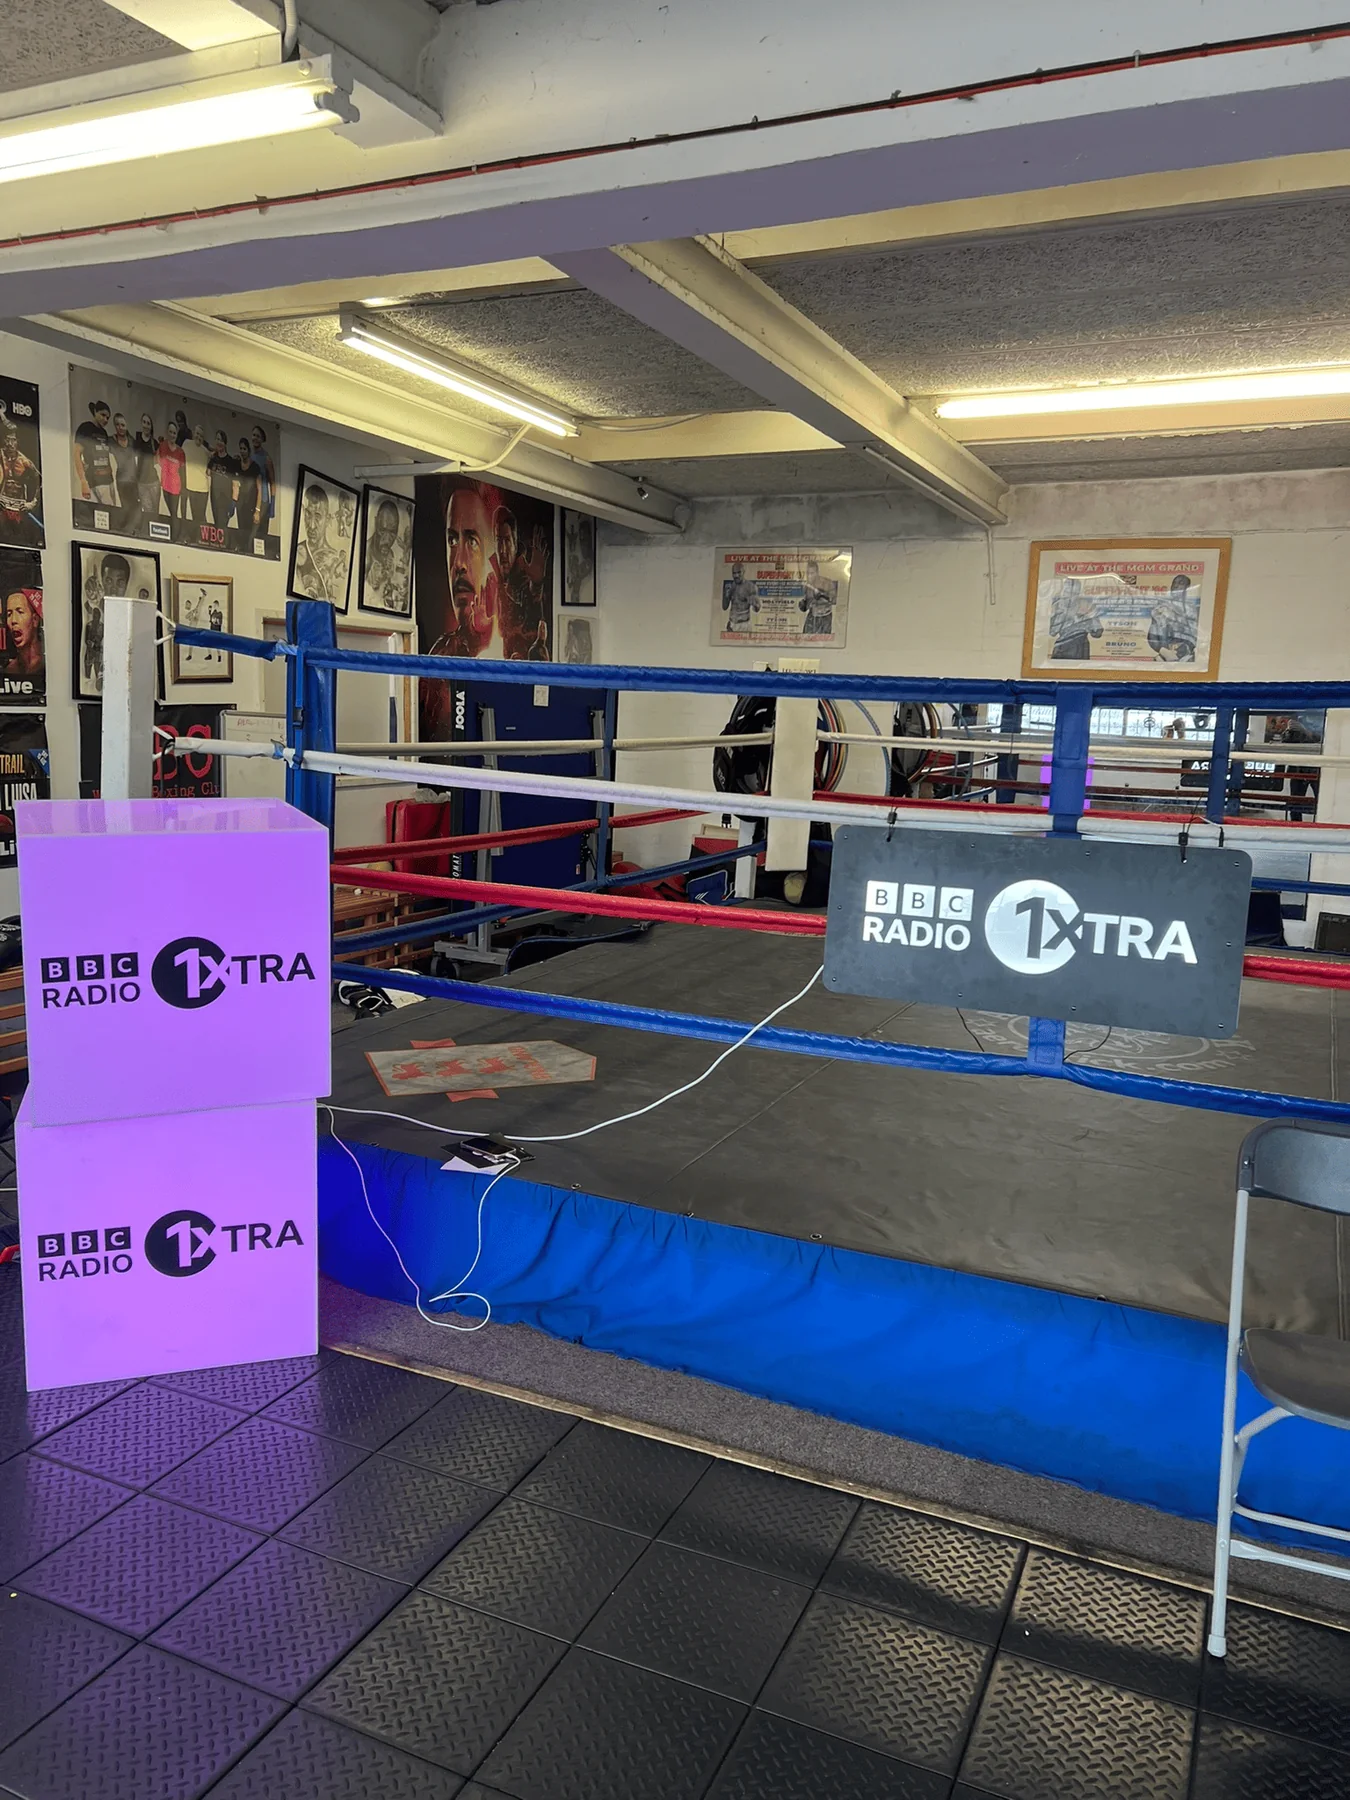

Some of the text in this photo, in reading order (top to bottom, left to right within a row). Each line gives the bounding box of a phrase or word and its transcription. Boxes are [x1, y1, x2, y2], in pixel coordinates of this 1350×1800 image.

[12, 401, 33, 417] HBO
[200, 525, 225, 543] WBC
[1060, 564, 1199, 573] LIVE AT THE MGM GRAND
[455, 690, 466, 730] JOOLA
[152, 781, 220, 798] Bxing Clu
[452, 854, 461, 877] OMAT
[869, 883, 970, 919] BBC
[862, 916, 971, 951] RADIO
[43, 954, 137, 982] BBC
[42, 981, 141, 1009] RADIO
[40, 1228, 130, 1257] BBC
[39, 1253, 133, 1282] RADIO
